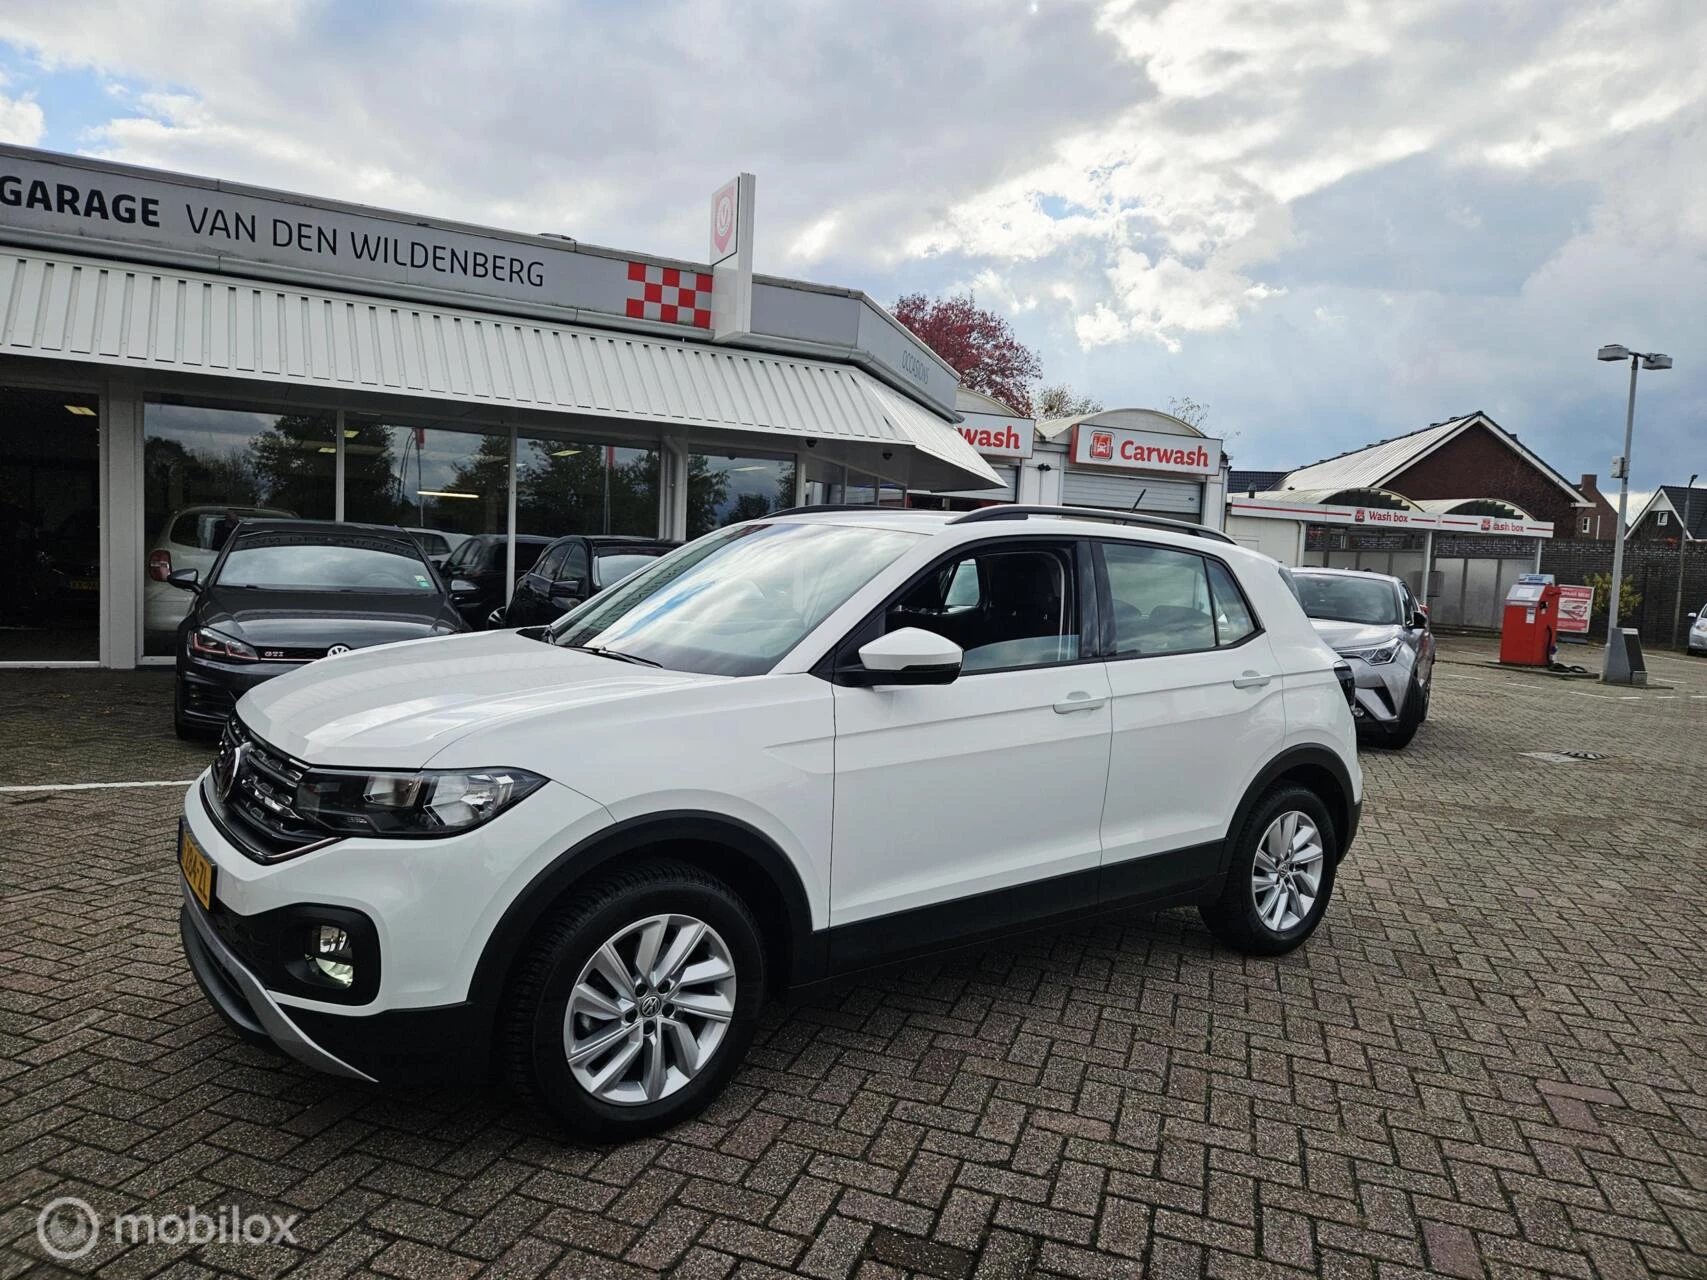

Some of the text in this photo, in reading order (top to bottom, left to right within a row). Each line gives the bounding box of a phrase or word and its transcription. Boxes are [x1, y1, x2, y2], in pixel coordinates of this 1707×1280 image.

[0, 175, 544, 287] GARAGE VAN DEN WILDENBERG
[1120, 440, 1208, 468] Carwash
[1368, 511, 1409, 523] Wash box
[1493, 521, 1524, 532] ash box
